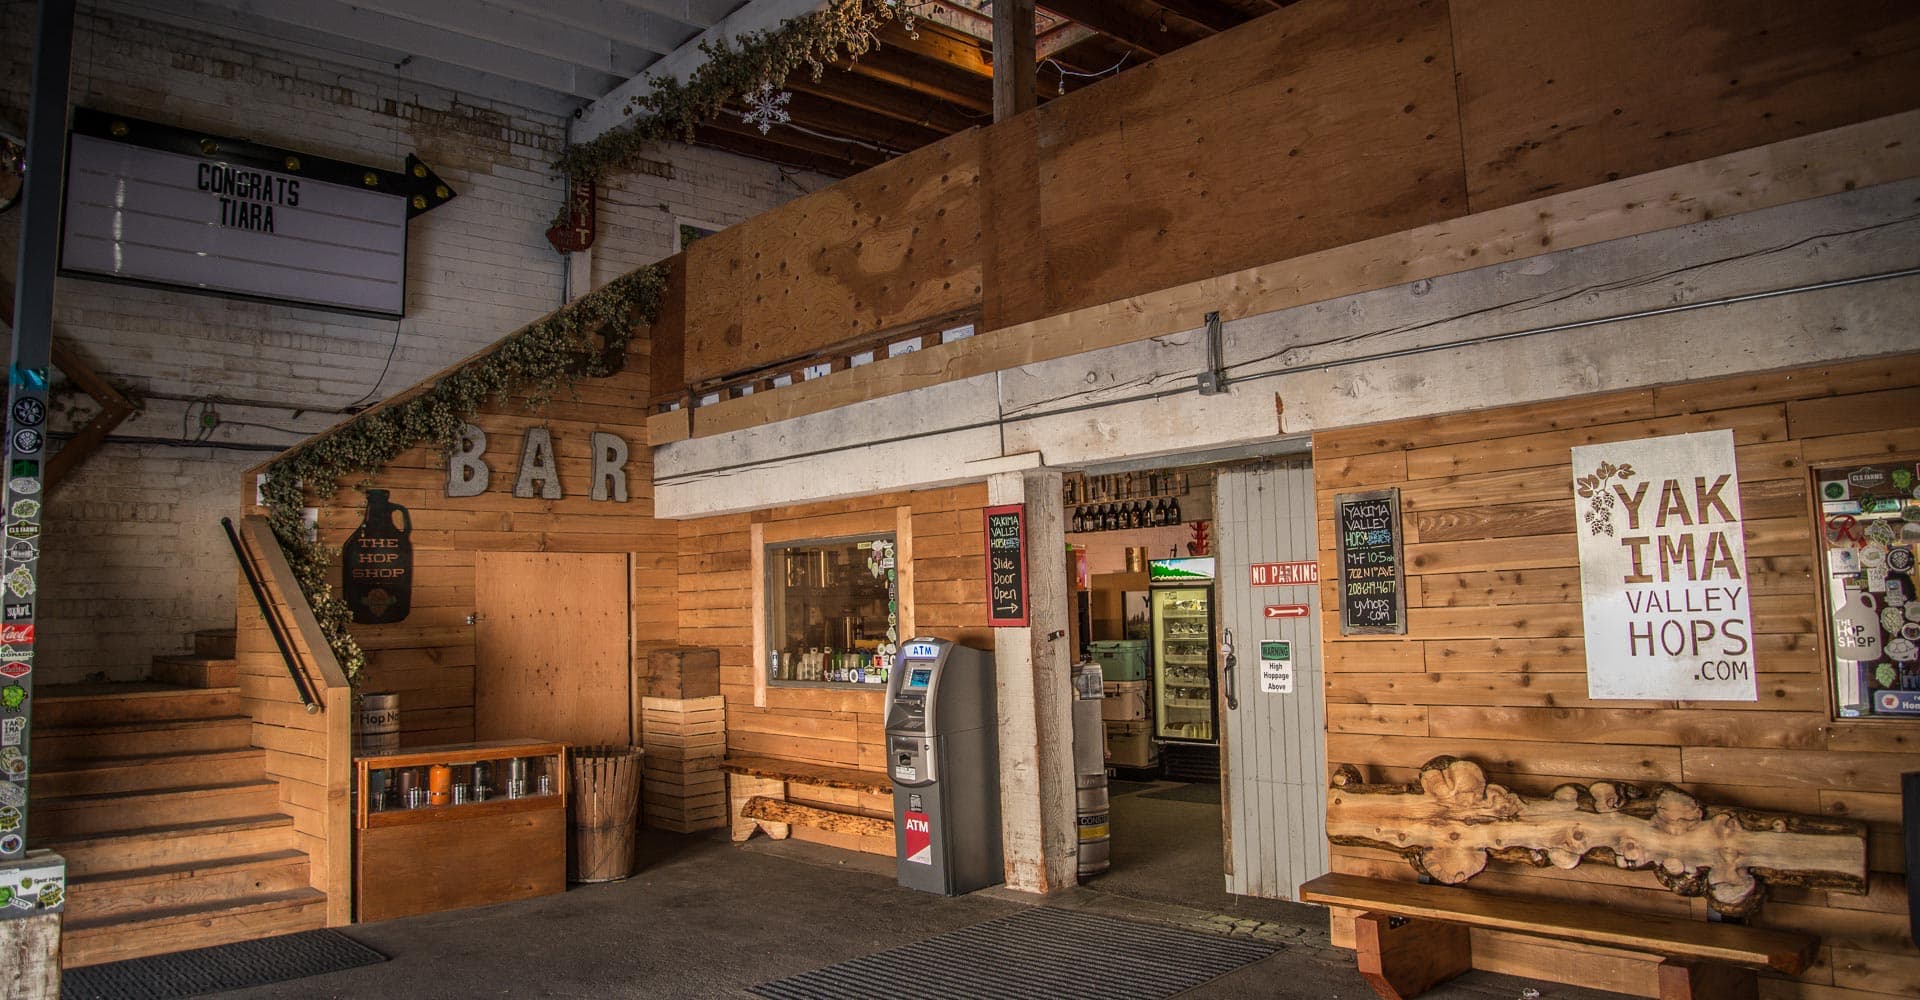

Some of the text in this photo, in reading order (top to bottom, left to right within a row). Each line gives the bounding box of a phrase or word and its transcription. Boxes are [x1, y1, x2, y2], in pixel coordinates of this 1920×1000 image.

[197, 162, 301, 207] CONGRATS
[219, 197, 275, 234] TIARA
[445, 423, 630, 502] BAR
[1612, 473, 1737, 530] YAK
[1346, 518, 1390, 531] VALLEY
[990, 526, 1019, 537] VALLEY
[358, 538, 399, 548] THE
[359, 552, 397, 564] HOP
[993, 557, 1015, 570] Slide
[1621, 531, 1742, 584] IMA
[352, 568, 405, 578] SHOP
[1252, 563, 1318, 584] NO PARKING
[1377, 565, 1395, 577] AVE
[993, 572, 1016, 585] Door
[993, 587, 1017, 604] Open
[1625, 586, 1743, 614] VALLEY
[1367, 610, 1390, 621] .com
[1629, 617, 1749, 657] HOPS
[1837, 625, 1865, 637] HOP
[1838, 636, 1876, 648] SHOP
[913, 645, 933, 656] ATM
[1262, 646, 1289, 657] WARNING
[1269, 662, 1283, 671] High
[1694, 660, 1749, 681] .COM
[1263, 671, 1290, 681] Hoppage
[1267, 682, 1286, 690] Above
[360, 713, 386, 726] Hop
[905, 818, 929, 833] ATM
